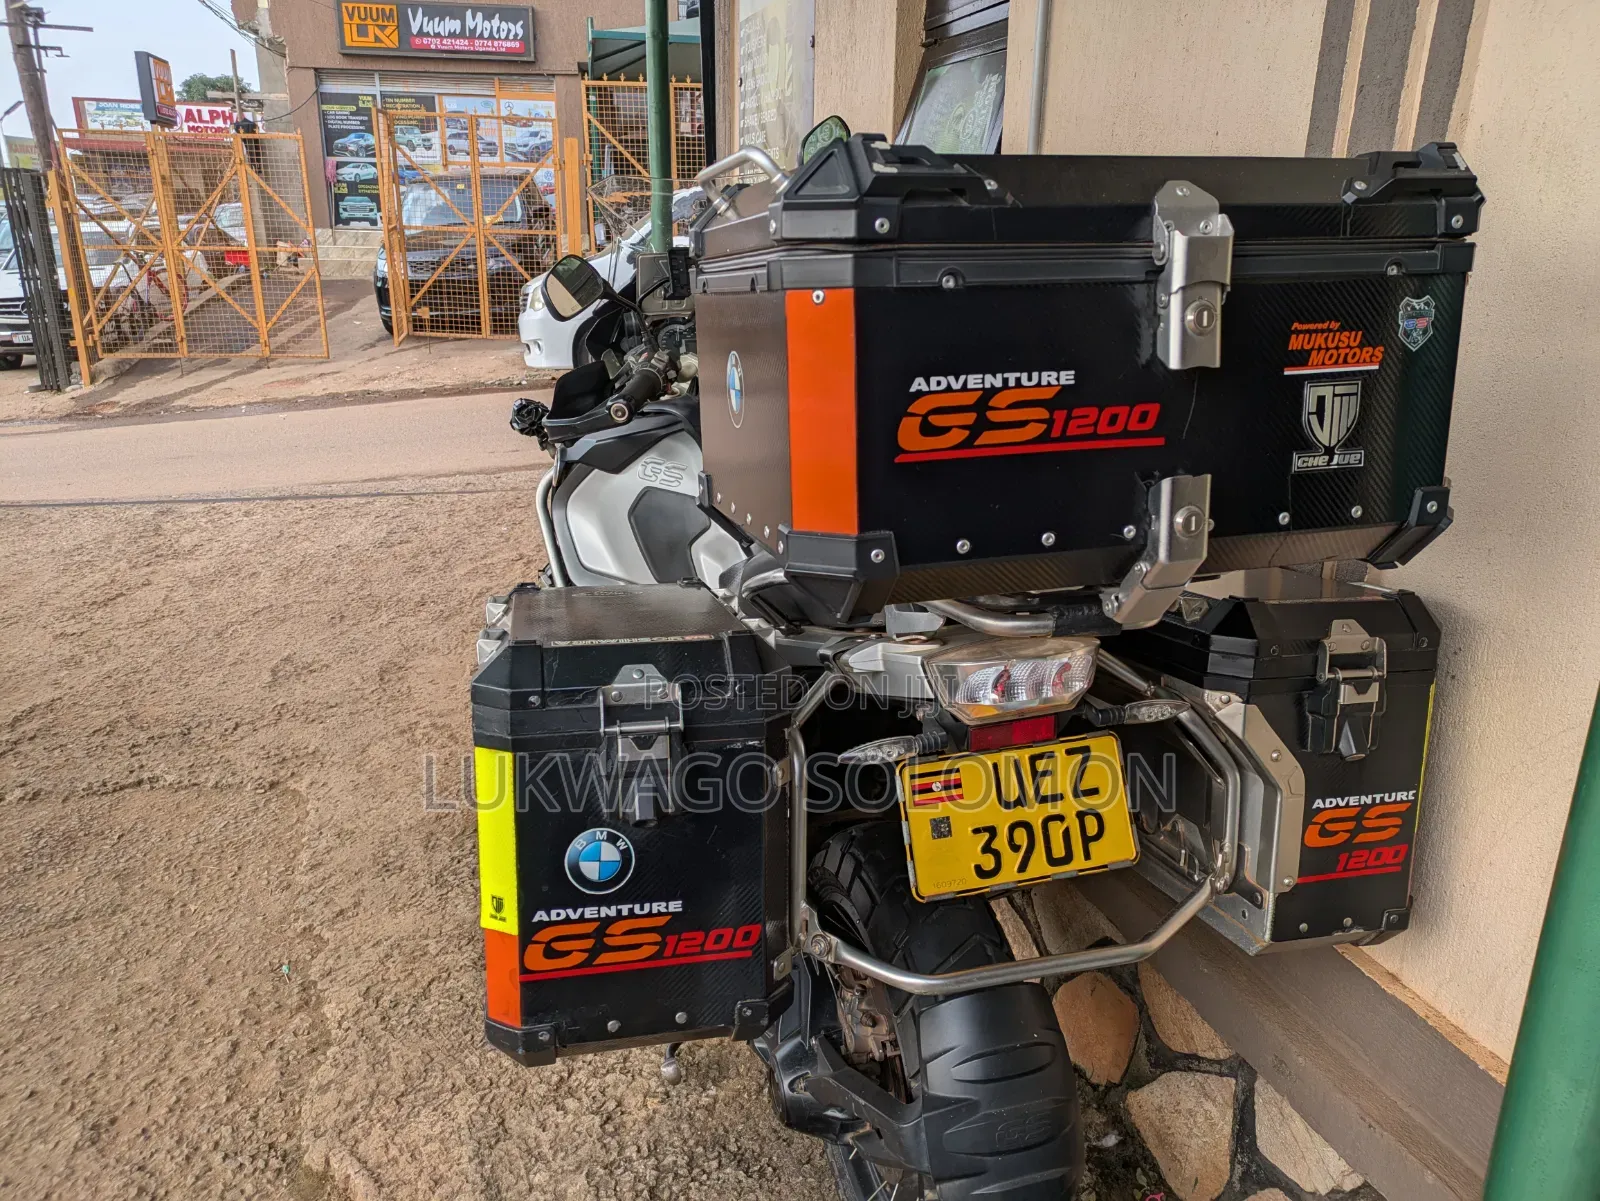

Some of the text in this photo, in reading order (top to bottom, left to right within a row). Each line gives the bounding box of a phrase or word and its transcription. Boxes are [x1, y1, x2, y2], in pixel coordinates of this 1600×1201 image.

[344, 6, 396, 23] VUUM
[408, 7, 524, 40] Vuum Motors
[1291, 321, 1341, 331] Powered by
[1288, 331, 1362, 350] MUKUSU
[1308, 346, 1385, 366] MOTORS
[909, 370, 1076, 393] ADVENTURE
[897, 385, 1161, 452] GS 1200
[637, 456, 688, 488] GS
[992, 745, 1100, 811] UEZ
[1311, 790, 1417, 810] ADVENTURE
[1303, 802, 1412, 848] GS
[574, 830, 628, 851] BMW
[971, 808, 1105, 880] 390P
[1336, 844, 1408, 872] 1200
[531, 901, 683, 922] ADVENTURE
[523, 915, 762, 971] GS 1200
